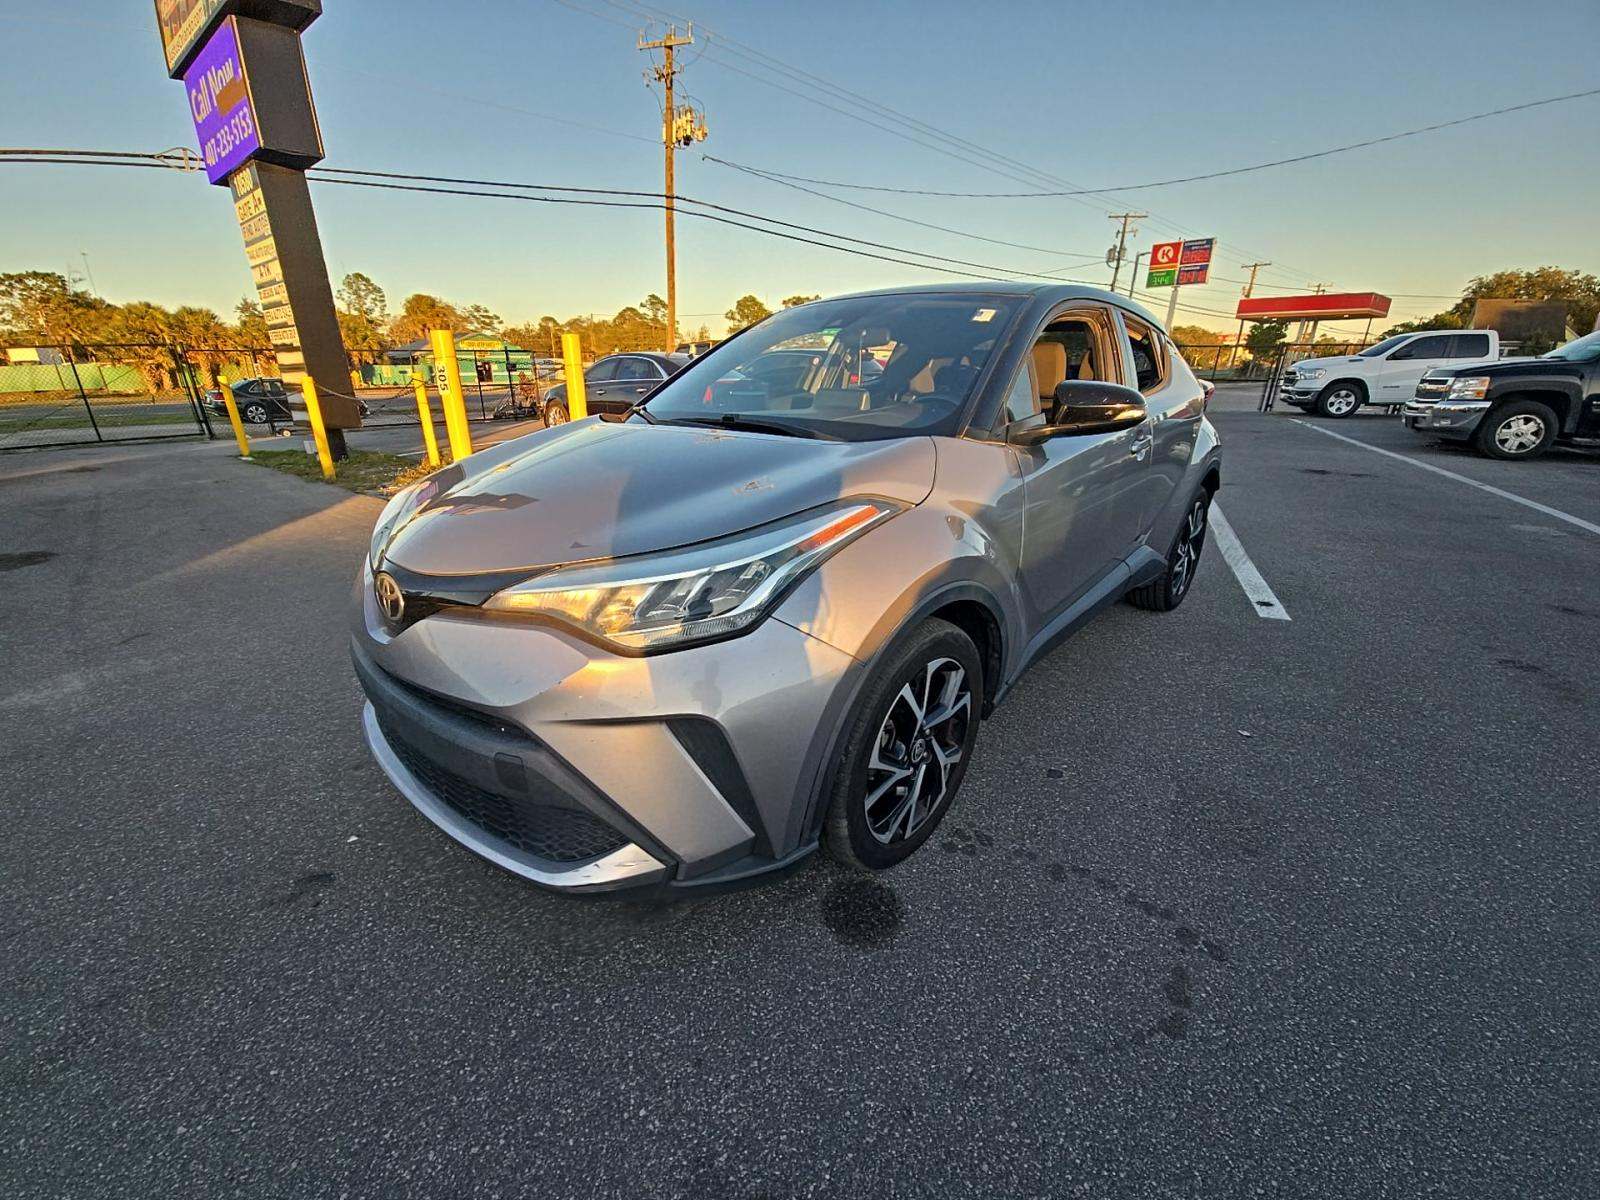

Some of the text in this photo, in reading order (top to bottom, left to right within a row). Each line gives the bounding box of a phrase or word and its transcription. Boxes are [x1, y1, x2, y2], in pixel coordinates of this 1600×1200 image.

[191, 58, 235, 123] Call Now
[205, 106, 253, 166] 407-233-5153
[437, 365, 449, 391] 305
